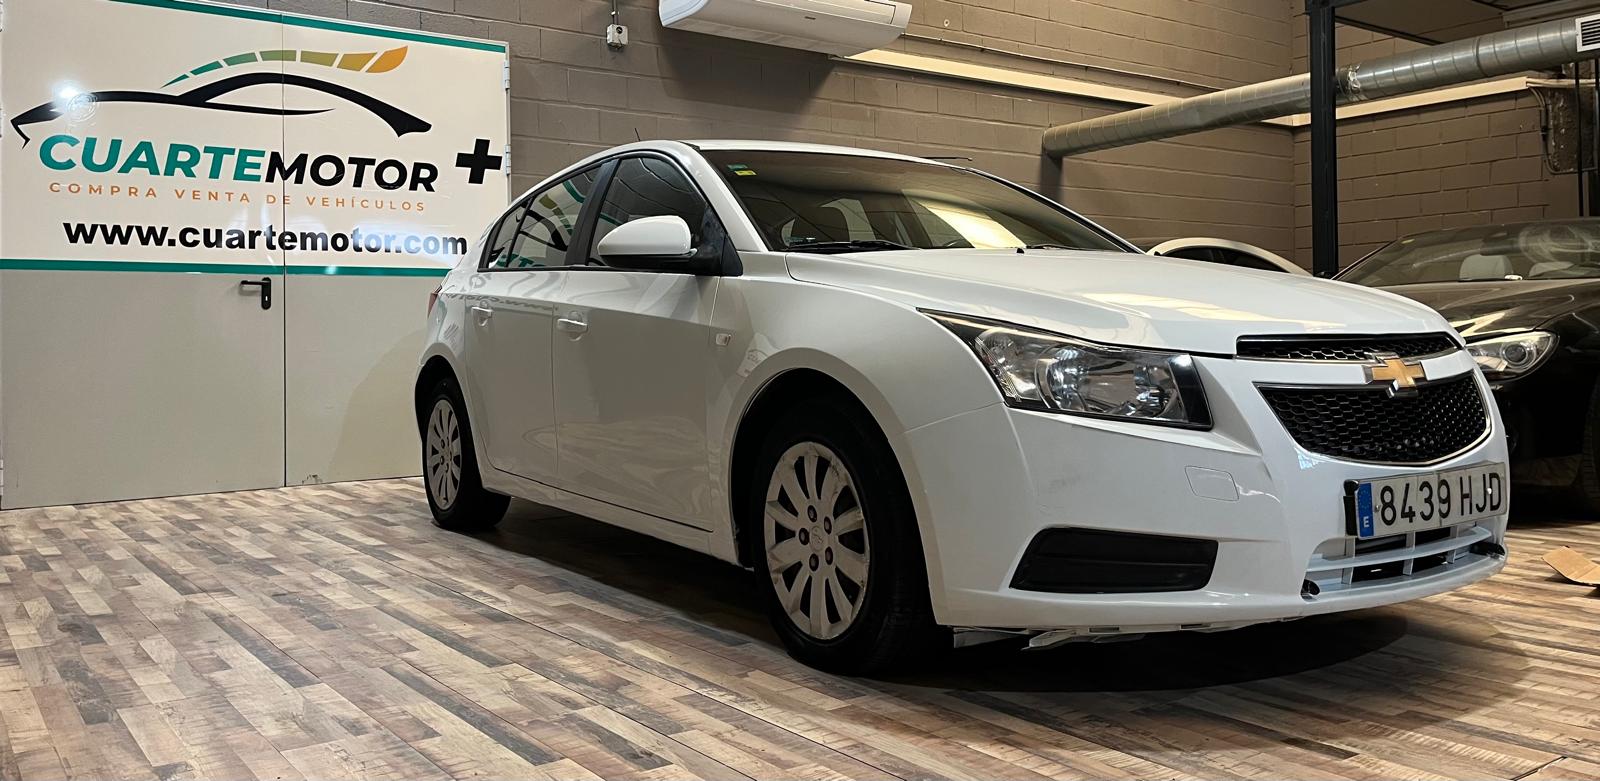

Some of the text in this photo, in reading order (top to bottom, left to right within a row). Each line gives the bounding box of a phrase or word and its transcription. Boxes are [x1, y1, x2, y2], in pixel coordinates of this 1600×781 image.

[49, 182, 425, 211] COMPRA VENTA DE VEHÍCULOS
[62, 220, 468, 256] www.cuartemotor.com
[1380, 472, 1501, 526] 8439 HJD
[1363, 516, 1370, 528] E
